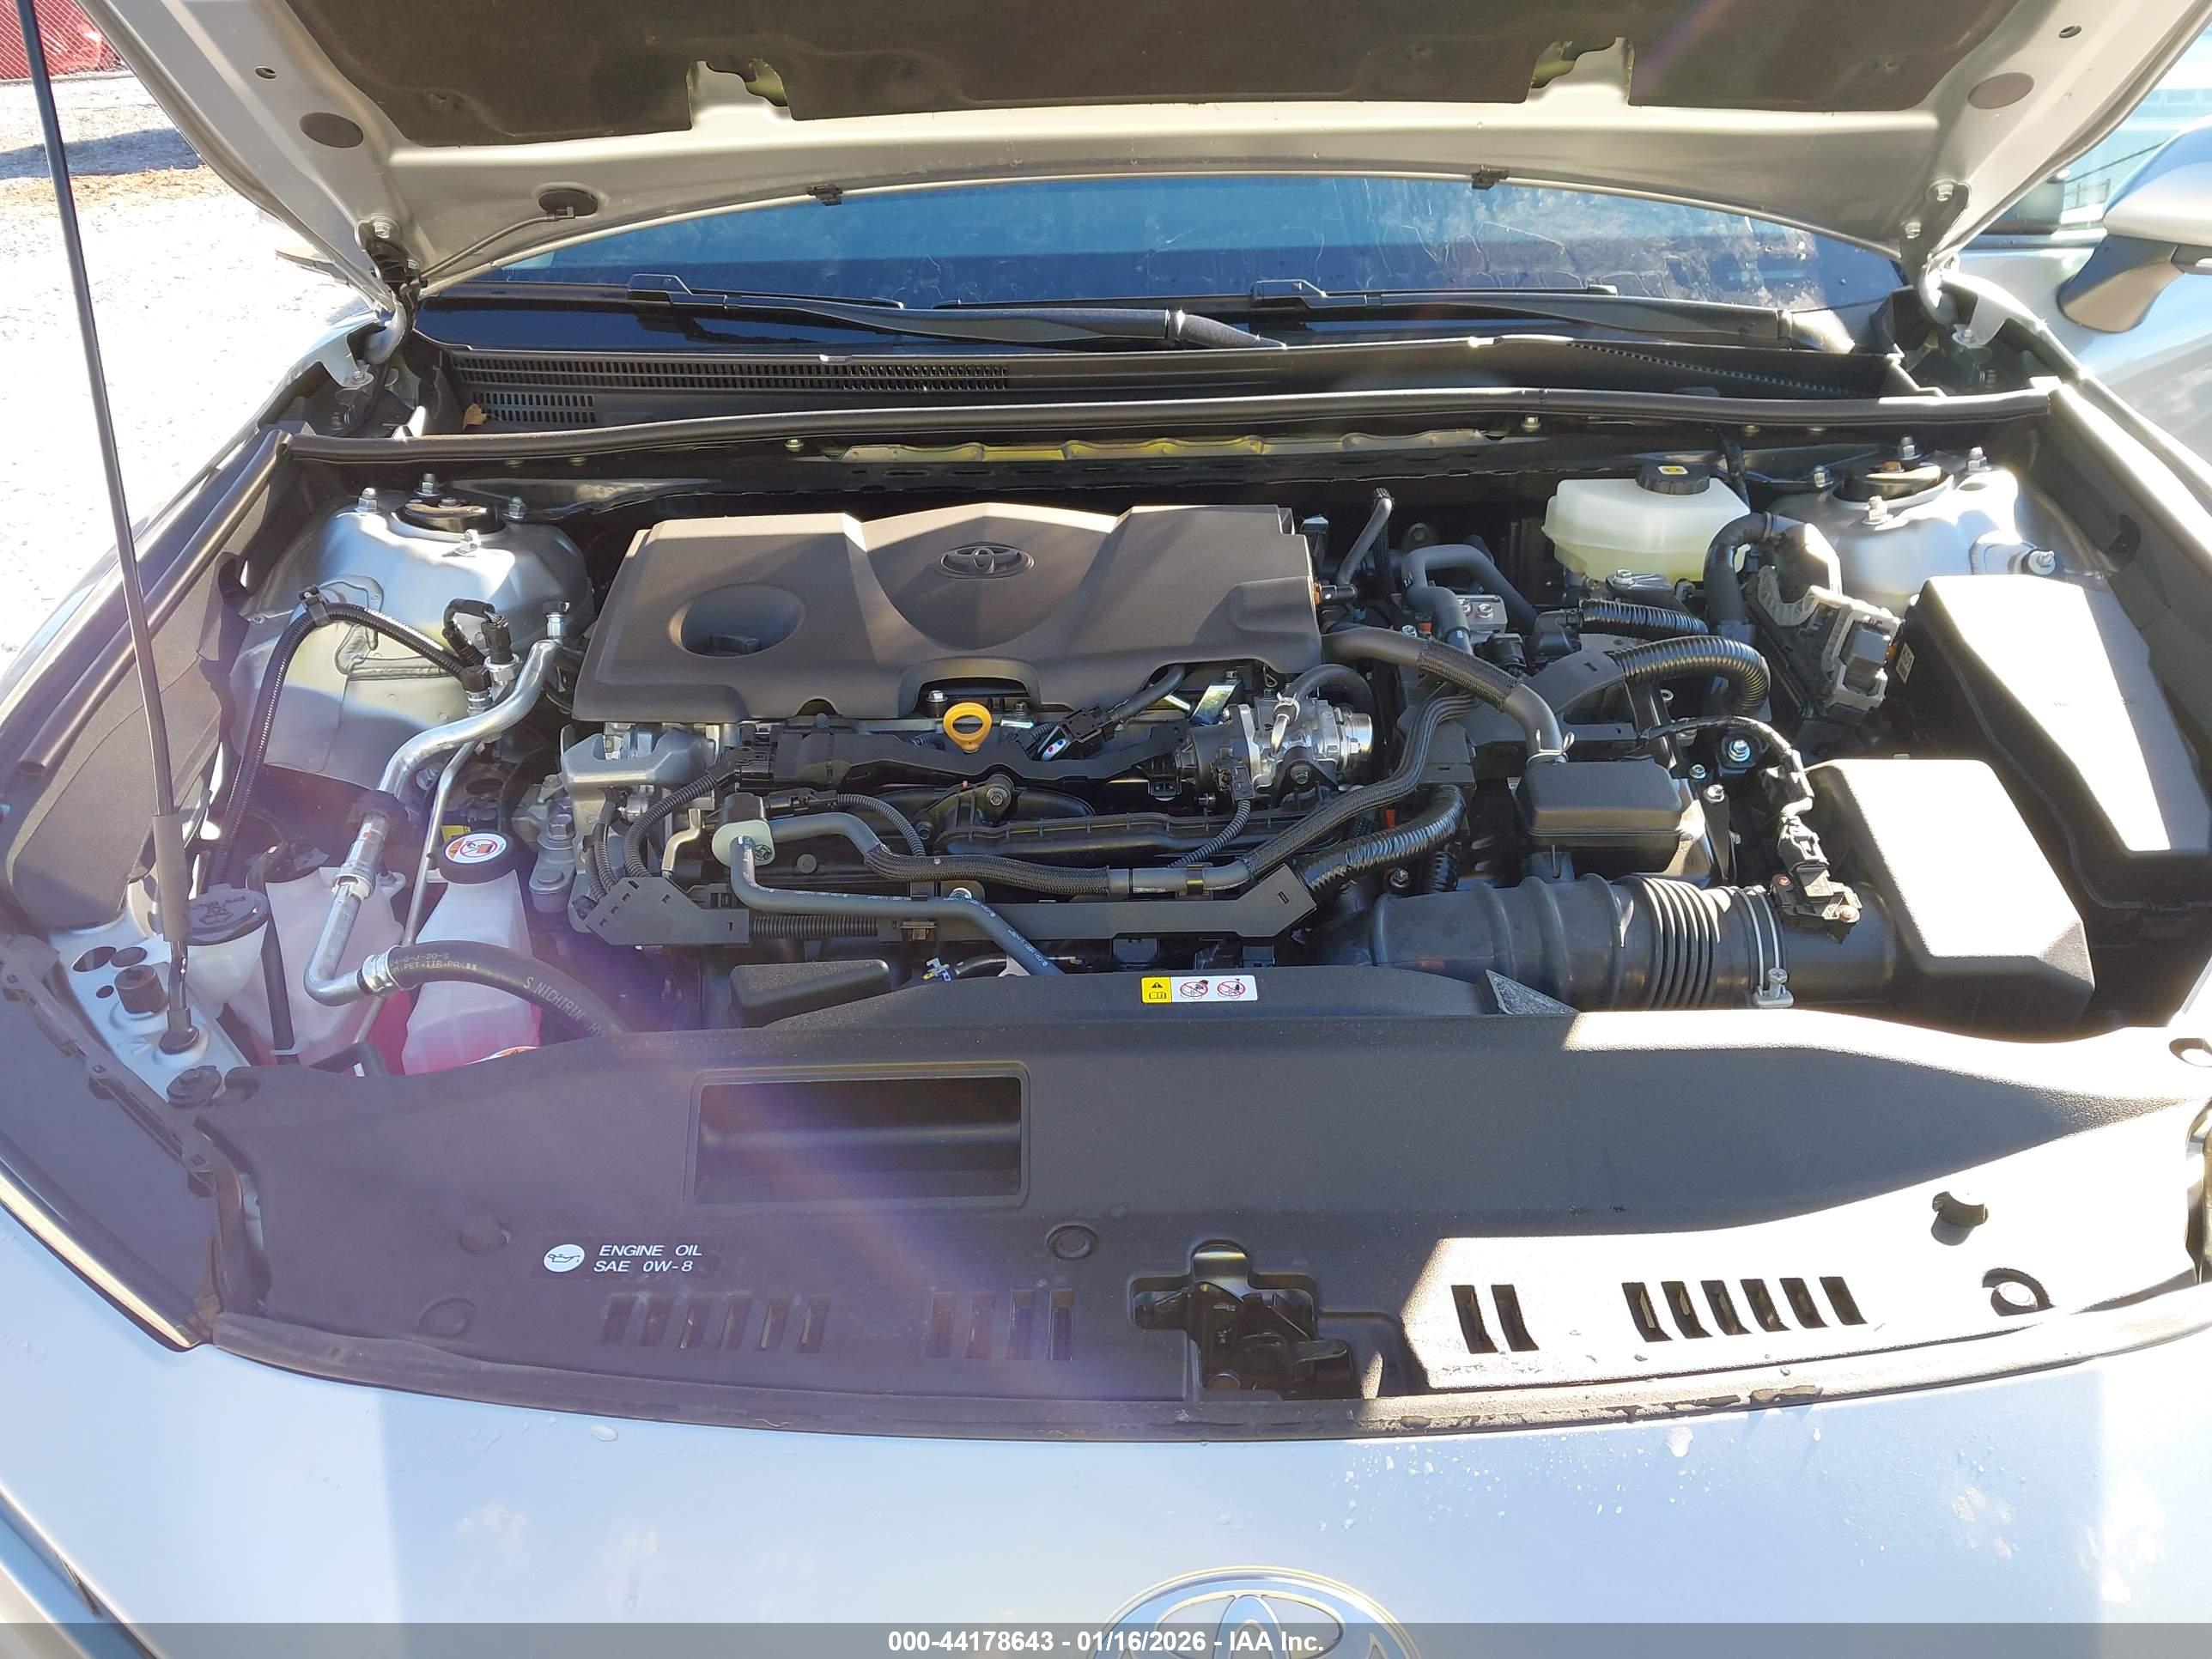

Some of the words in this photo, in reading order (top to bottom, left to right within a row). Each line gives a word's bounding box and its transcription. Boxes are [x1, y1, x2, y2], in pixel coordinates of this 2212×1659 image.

[534, 981, 586, 1022] NICHIRIN
[599, 1244, 665, 1256] ENGINE
[675, 1244, 702, 1256] OIL
[593, 1260, 631, 1273] SAE
[642, 1260, 693, 1273] 0W-8
